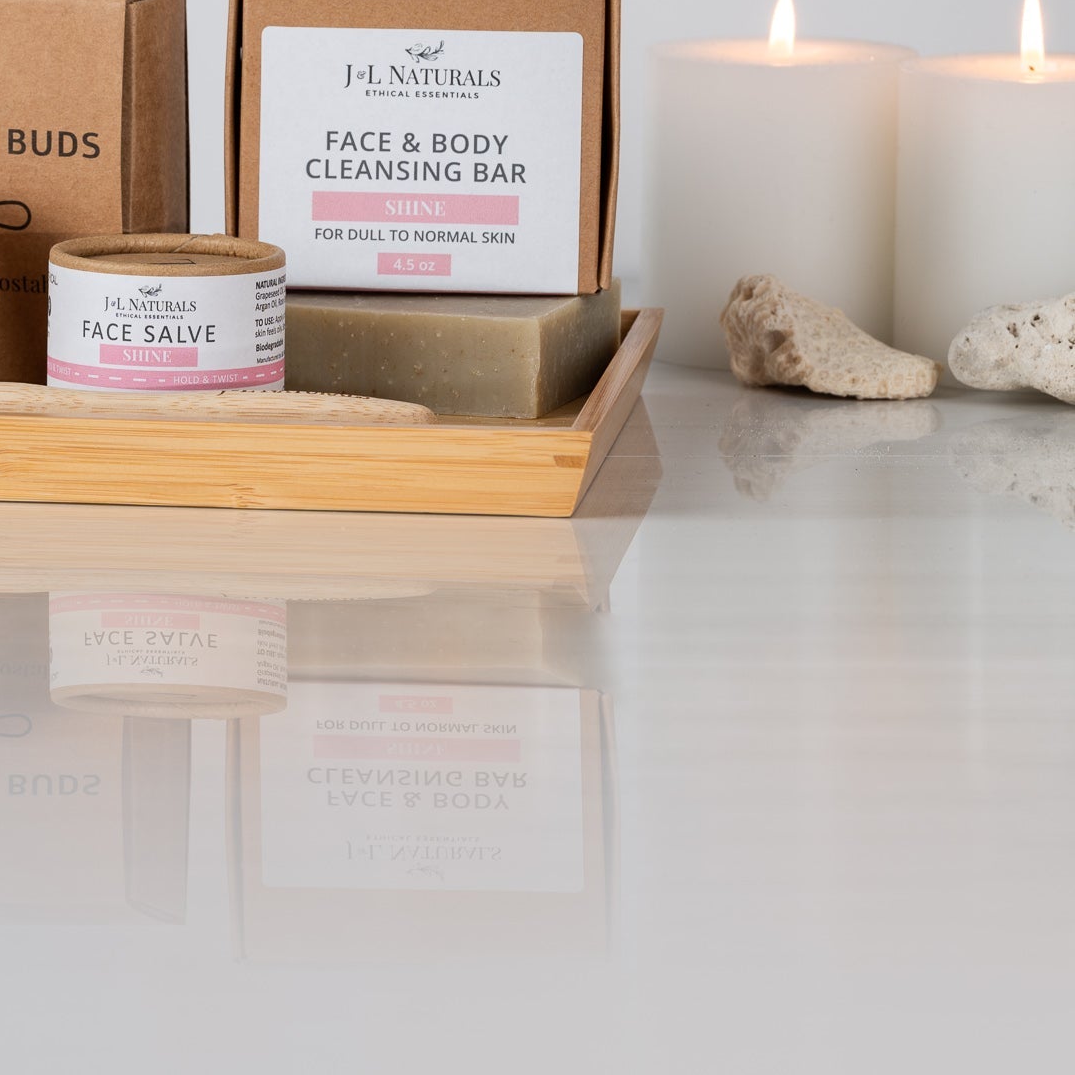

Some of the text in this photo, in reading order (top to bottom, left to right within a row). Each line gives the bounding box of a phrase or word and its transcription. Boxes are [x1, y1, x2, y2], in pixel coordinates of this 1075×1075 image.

[344, 64, 501, 88] J&L NATURALS
[365, 89, 480, 99] ETHICAL ESSENTIALS
[8, 129, 102, 159] BUDS
[325, 131, 509, 155] FACE & BODY
[305, 158, 527, 184] CLEANSING BAR
[385, 200, 446, 216] SHINE
[315, 228, 515, 244] FOR DULL TO NORMAL SKIN
[393, 259, 436, 271] 4.5 oz
[256, 278, 278, 289] NATURAL
[256, 289, 279, 301] Grapeseed
[104, 296, 197, 313] J&L NATURALS
[255, 302, 270, 312] Argan
[255, 318, 263, 327] TO
[82, 320, 216, 344] FACE SALVE
[255, 328, 266, 338] skin
[123, 349, 172, 363] SHINE
[174, 374, 239, 385] HOLD & TWIST
